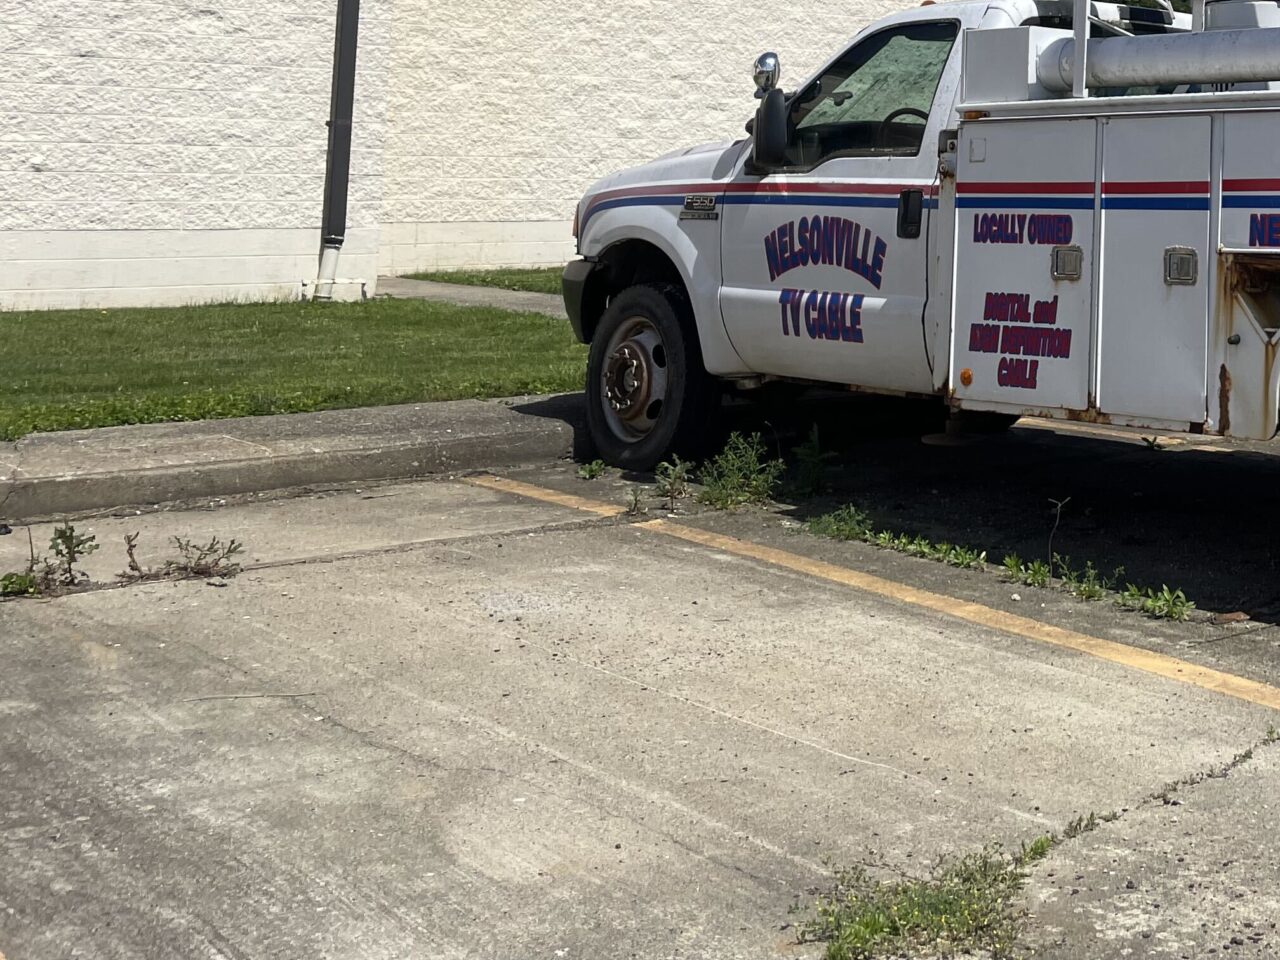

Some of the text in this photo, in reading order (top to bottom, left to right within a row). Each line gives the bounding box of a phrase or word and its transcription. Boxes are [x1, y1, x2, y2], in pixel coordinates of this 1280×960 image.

[974, 213, 1073, 244] LOCALLY OWNED
[764, 215, 887, 290] NELSONVILLE
[779, 288, 864, 343] TV CABLE
[983, 292, 1058, 324] DIGITAL and
[969, 323, 1072, 358] HIGH DEFINITION
[998, 357, 1039, 389] CABLE
